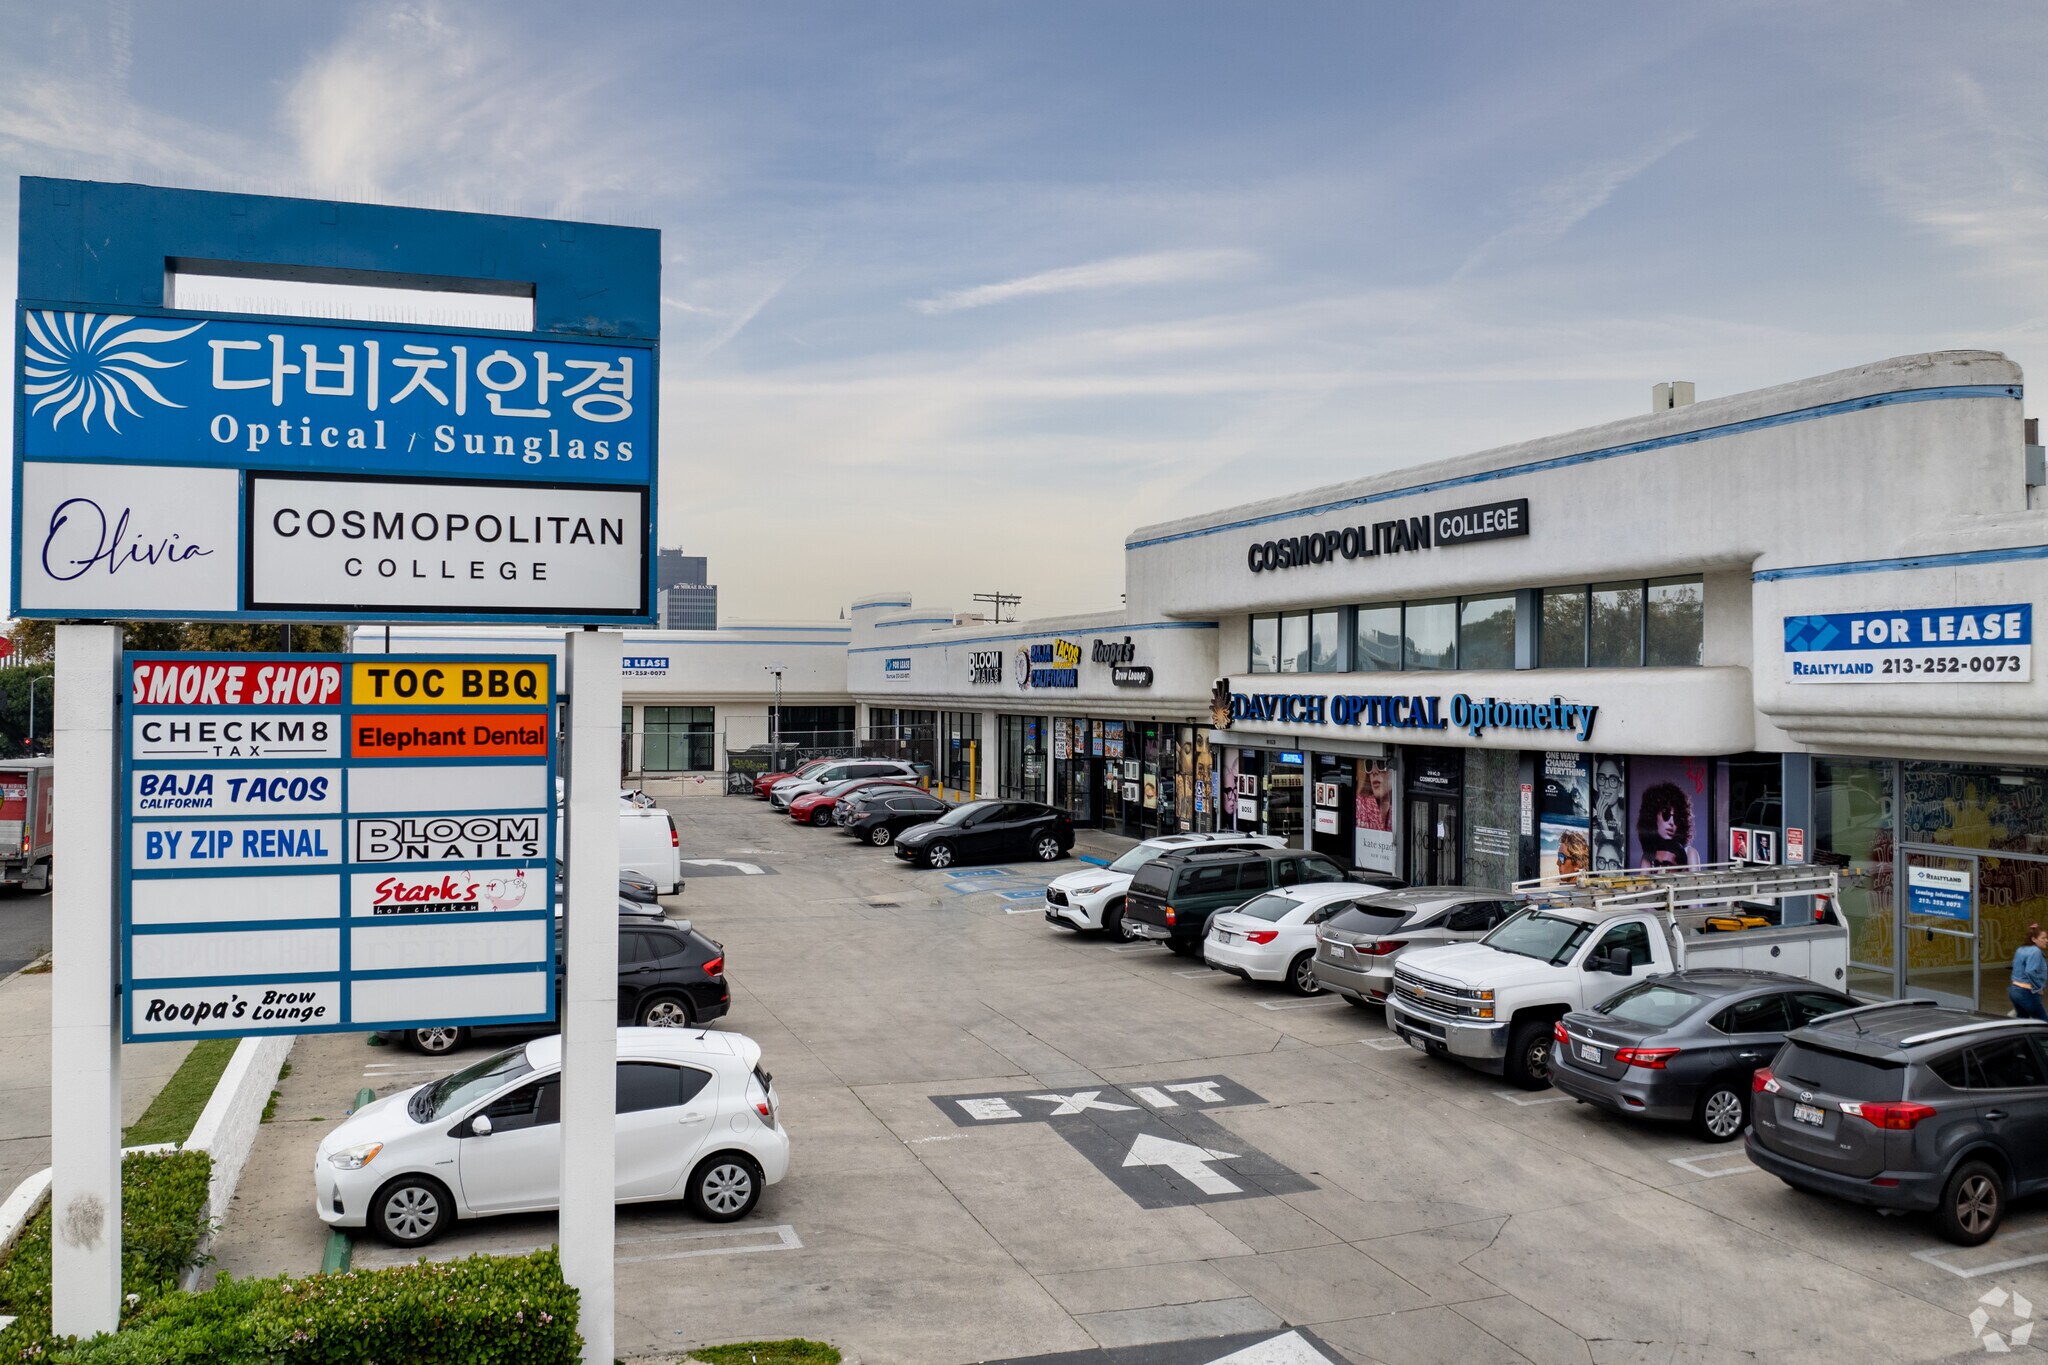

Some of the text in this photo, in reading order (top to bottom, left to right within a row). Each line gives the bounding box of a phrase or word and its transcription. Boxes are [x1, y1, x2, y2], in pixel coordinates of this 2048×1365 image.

[208, 333, 635, 424] 다비치안경
[210, 413, 387, 452] Optical
[433, 424, 635, 465] Sunglass
[42, 497, 214, 581] Olivia
[272, 507, 625, 547] COSMOPOLITAN
[1248, 506, 1520, 573] COSMOPOLITAN COLLEGE
[344, 557, 549, 582] COLLEGE
[1850, 612, 2022, 645] FOR LEASE
[635, 659, 667, 668] LEASE
[1055, 638, 1082, 664] TACOS
[968, 651, 1002, 682] BLOOM
[1030, 668, 1079, 688] CALIFORNIA
[1793, 654, 2022, 676] REALTYLAND 213-252-0073
[133, 664, 341, 706] SMOKE SHOP
[368, 668, 539, 701] TOC BBQ
[1231, 692, 1599, 742] DAVICH OPTICAL Optometry
[141, 721, 329, 743] CHECKM8
[358, 725, 545, 751] Elephant Dental
[212, 745, 261, 758] TAX
[1545, 751, 1580, 761] ONE WAVE
[1545, 759, 1577, 769] CHANGES
[1545, 767, 1586, 777] EVERYTHING
[139, 773, 329, 803] BAJA TACOS
[139, 797, 213, 810] CALIFORNIA
[146, 828, 329, 860] BY ZIP RENAL
[356, 818, 539, 862] BLOOM
[406, 842, 539, 860] NAILS
[1363, 838, 1377, 849] kate
[372, 870, 480, 905] Stark's
[1915, 889, 1965, 900] Leasing Information
[376, 903, 478, 915] hot chicken
[145, 994, 248, 1025] Roopa's
[262, 990, 317, 1005] Brow
[251, 1003, 326, 1024] Lounge
[955, 1081, 1226, 1120] EXIT
